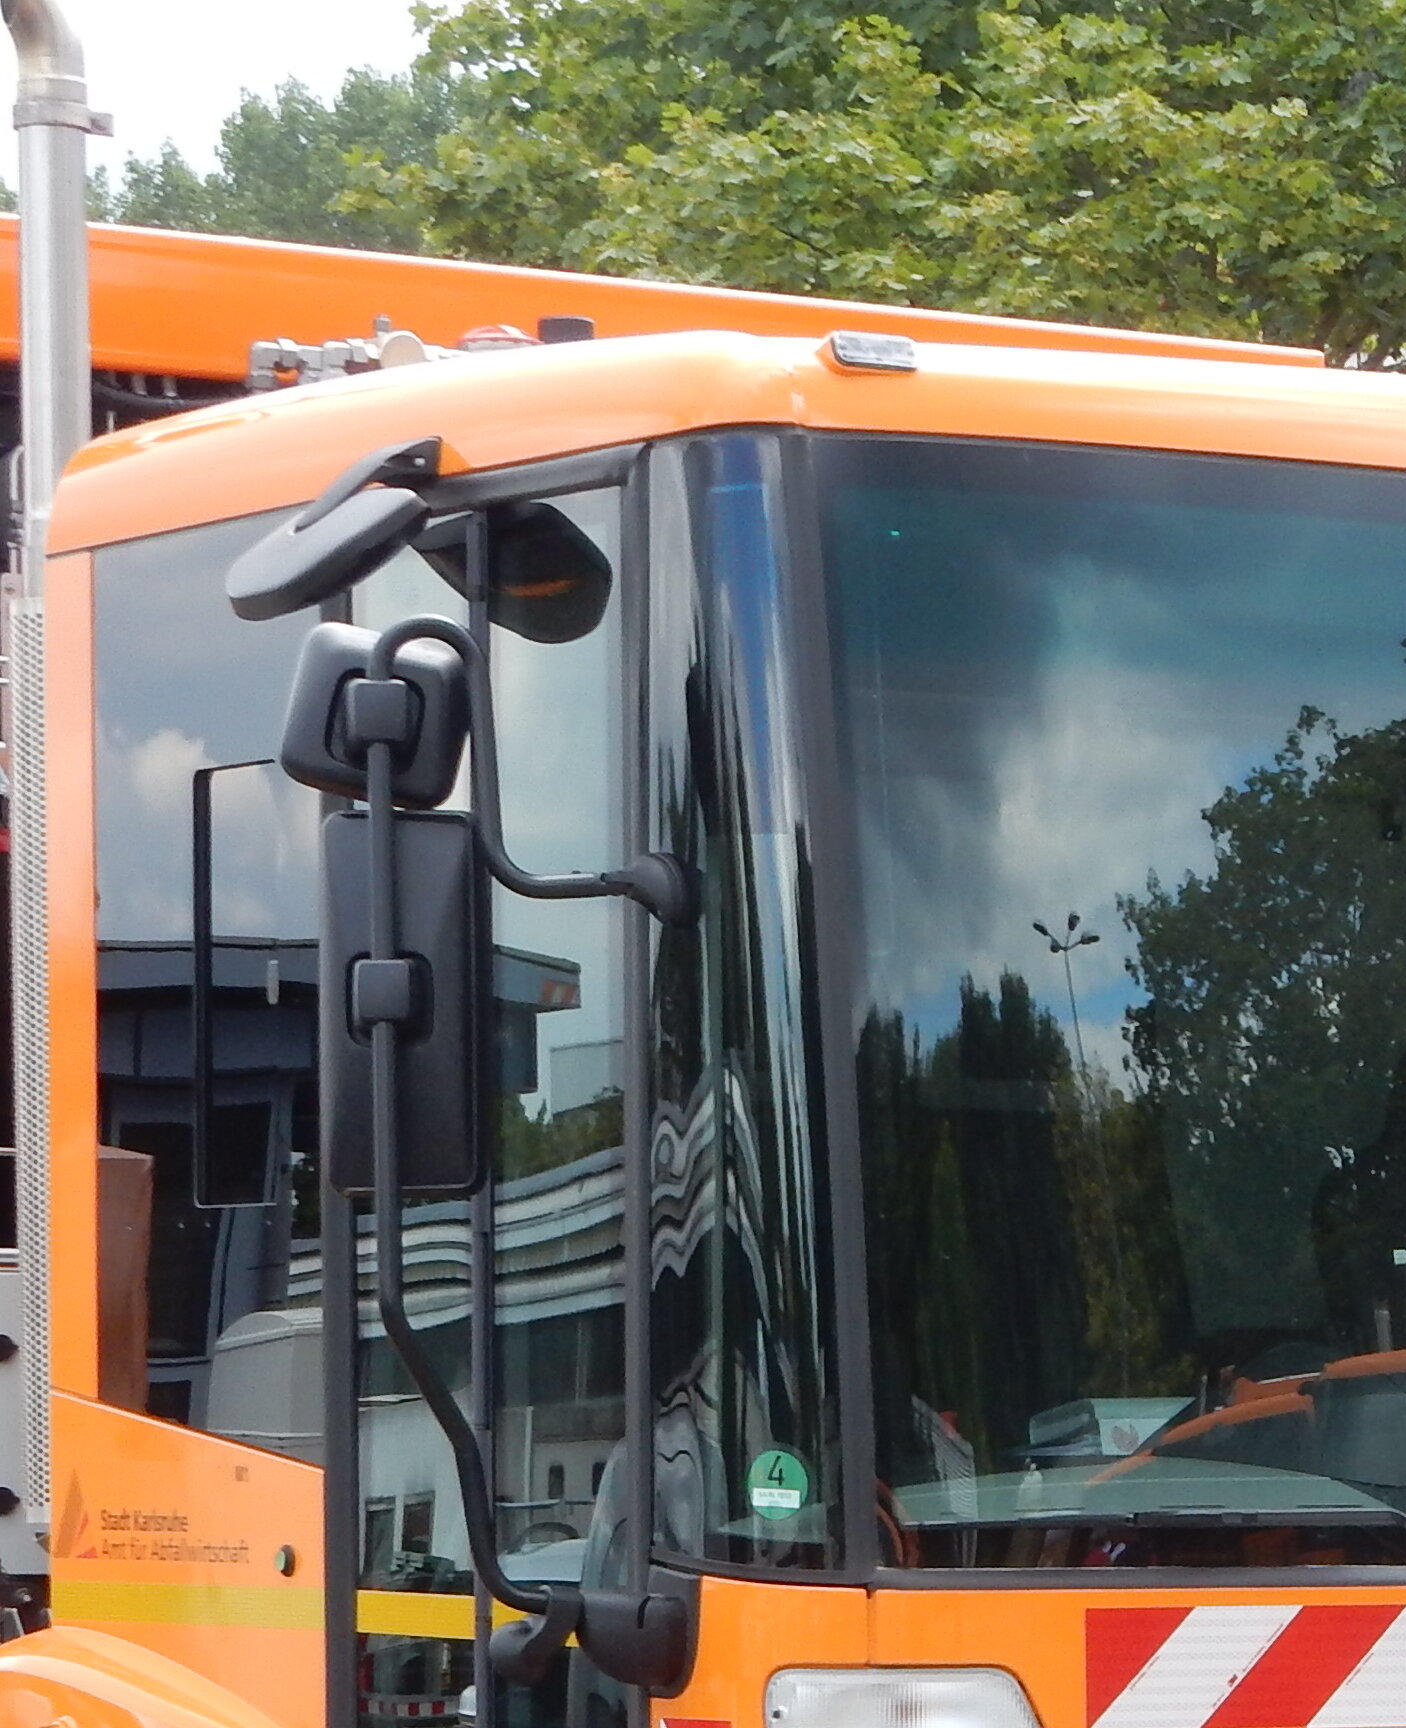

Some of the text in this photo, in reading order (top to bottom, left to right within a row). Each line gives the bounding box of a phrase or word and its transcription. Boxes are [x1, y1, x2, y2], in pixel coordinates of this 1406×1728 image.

[767, 1455, 785, 1487] 4
[101, 1509, 189, 1533] Stadt Karlsruhe
